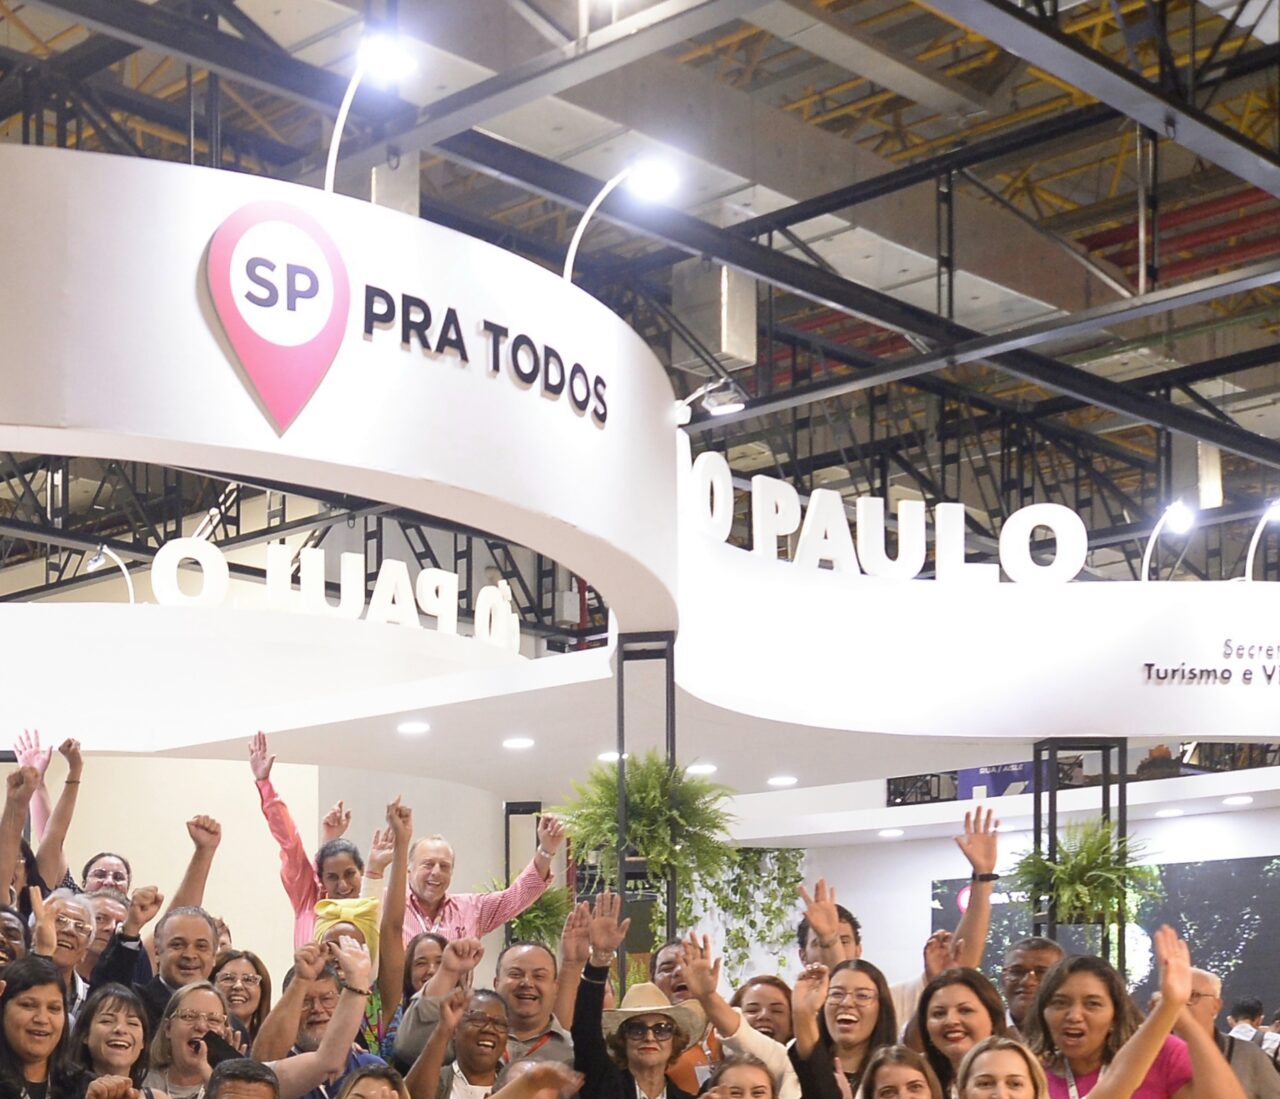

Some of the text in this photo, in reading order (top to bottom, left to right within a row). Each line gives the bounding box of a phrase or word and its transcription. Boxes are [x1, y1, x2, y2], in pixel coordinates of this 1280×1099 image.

[244, 257, 319, 311] SP
[364, 285, 609, 424] PRA TODOS
[751, 474, 1088, 583] PAULO
[1144, 662, 1233, 681] Turismo
[1243, 669, 1253, 682] e
